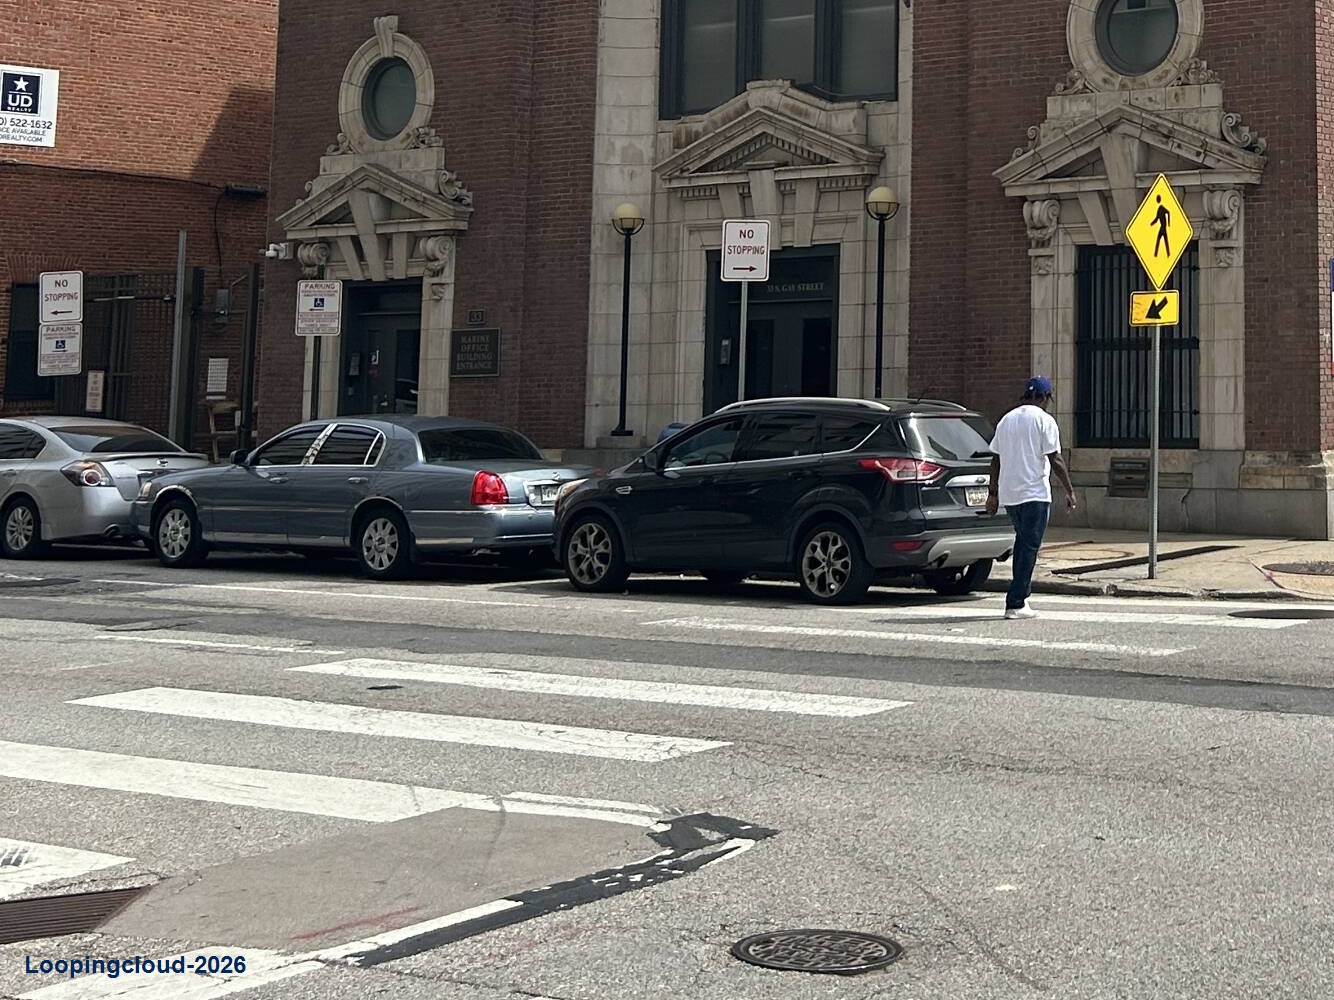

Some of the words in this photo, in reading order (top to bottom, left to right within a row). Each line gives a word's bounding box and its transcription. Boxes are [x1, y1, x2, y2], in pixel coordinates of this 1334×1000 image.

[8, 94, 33, 108] UD
[9, 118, 53, 130] 522-1632
[11, 128, 47, 137] AVAILABLE
[739, 229, 755, 239] NO
[727, 245, 765, 255] STOPPING
[54, 279, 68, 288] NO
[798, 282, 825, 291] STREET
[44, 292, 79, 302] STOPPING
[46, 325, 76, 333] PARKING
[460, 343, 489, 352] OFFICE
[456, 352, 496, 361] BUILDING
[456, 361, 493, 370] ENTRANCE
